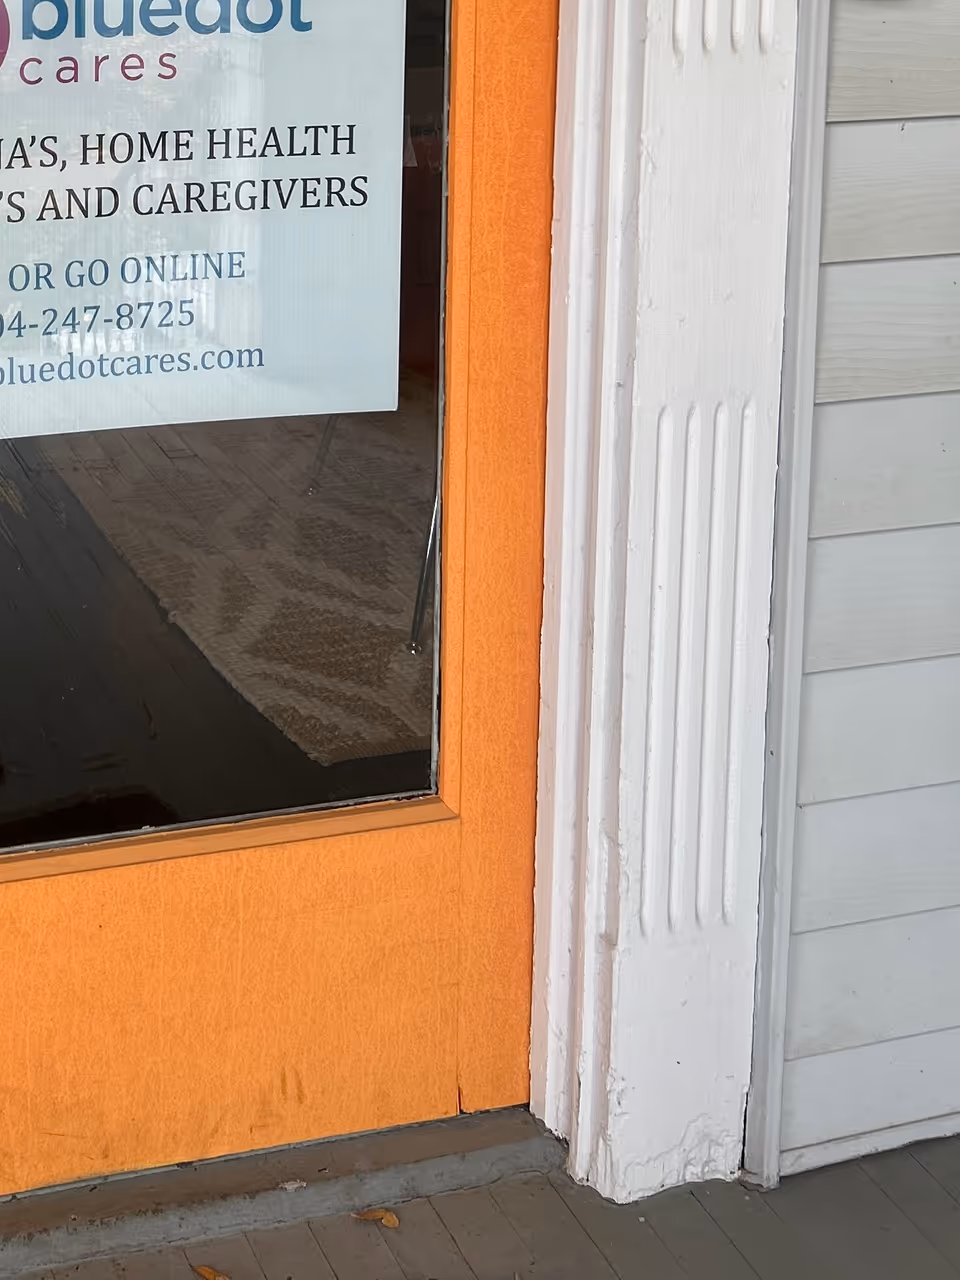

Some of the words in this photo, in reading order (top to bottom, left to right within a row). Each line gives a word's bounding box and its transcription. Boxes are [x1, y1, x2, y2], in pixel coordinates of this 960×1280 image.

[19, 50, 178, 85] cares
[80, 129, 194, 166] HOME
[206, 124, 357, 160] HEALTH
[36, 186, 120, 222] AND
[132, 176, 369, 217] CAREGIVERS
[8, 262, 56, 293] OR
[64, 258, 110, 289] GO
[120, 251, 246, 285] ONLINE
